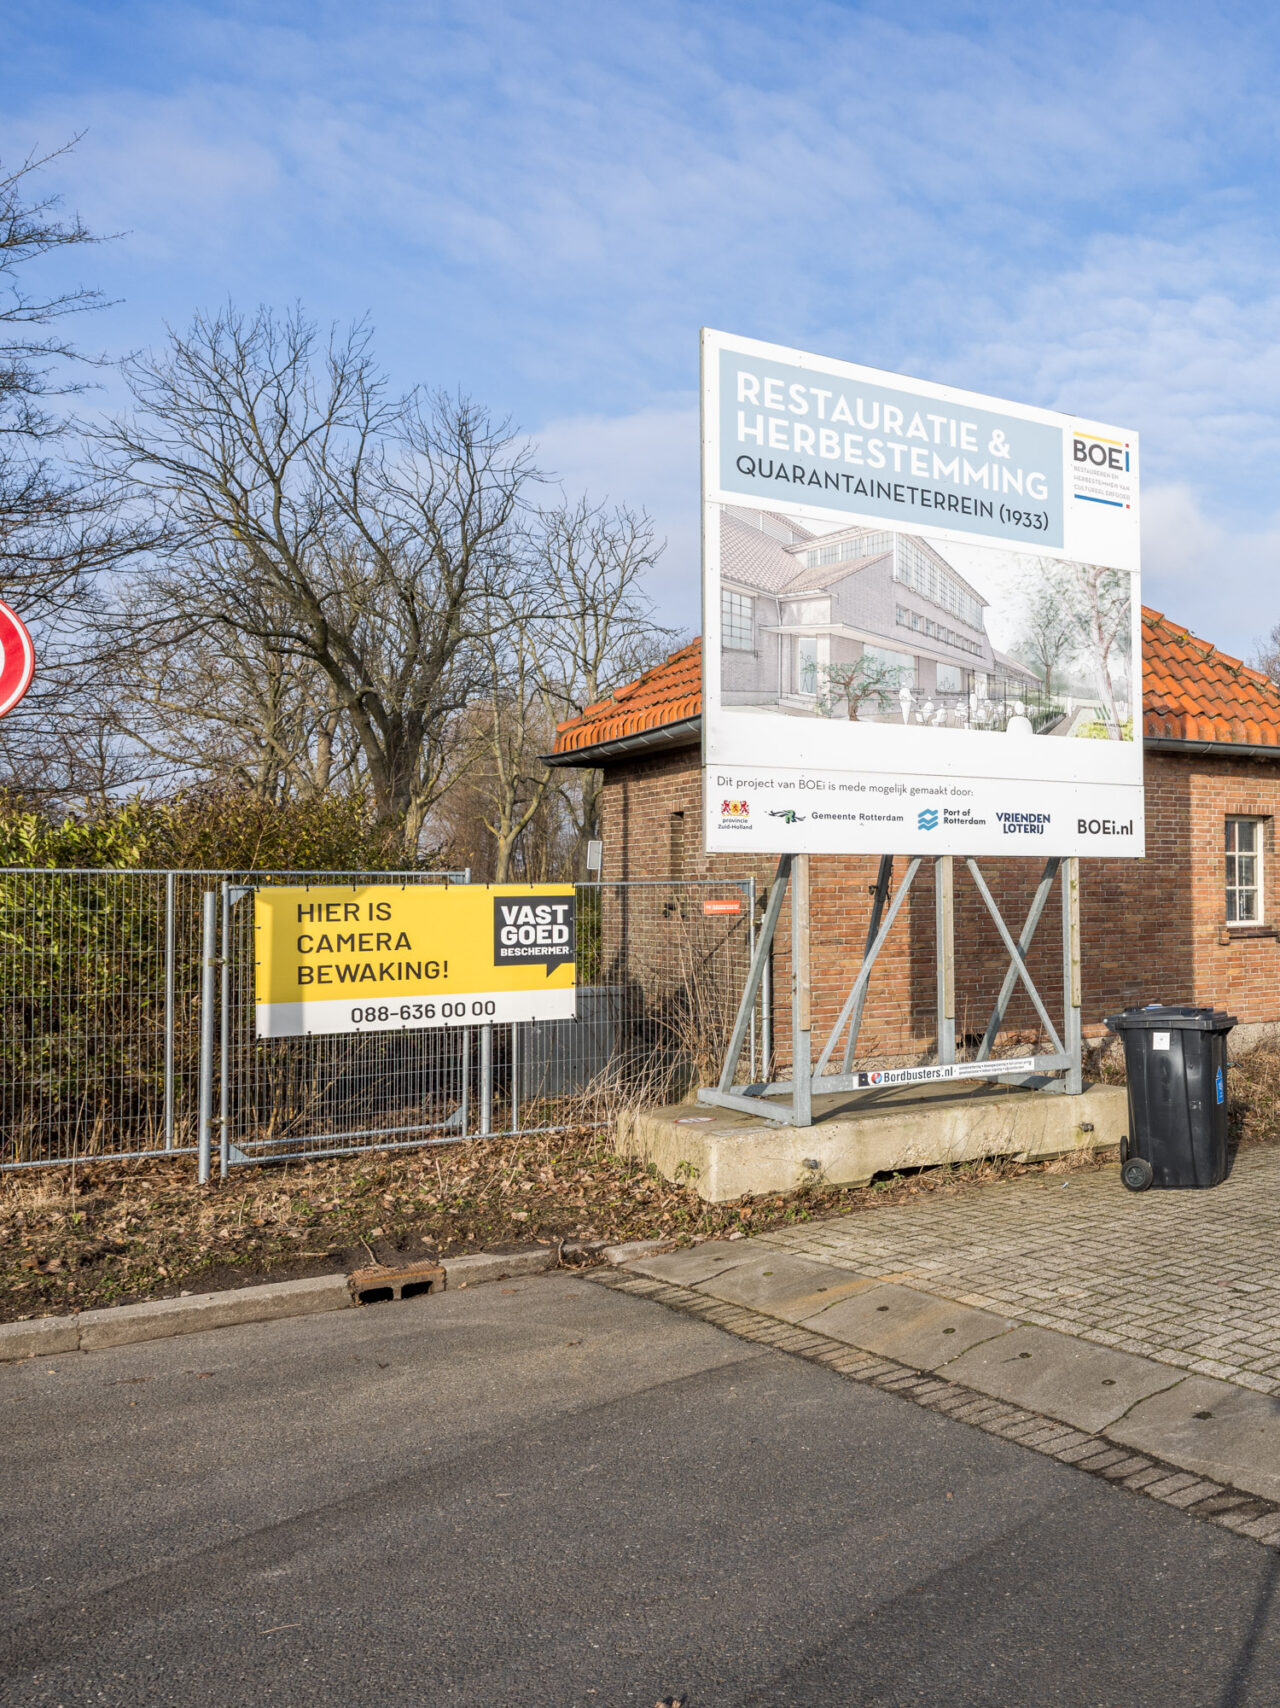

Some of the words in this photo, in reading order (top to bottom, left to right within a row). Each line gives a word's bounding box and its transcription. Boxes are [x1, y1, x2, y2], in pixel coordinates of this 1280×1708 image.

[737, 371, 978, 452] RESTAURATIE
[988, 429, 1011, 459] &
[737, 410, 1048, 500] HERBESTEMMING
[736, 455, 993, 518] QUARANTAINETERREIN
[1000, 503, 1049, 531] (1933)
[717, 776, 733, 787] Dit
[736, 778, 774, 790] project
[777, 781, 796, 789] van
[799, 779, 826, 790] BOEi
[828, 781, 836, 791] is
[839, 782, 866, 792] mede
[869, 784, 907, 796] mogelijk
[910, 786, 947, 796] gemaakt
[950, 786, 974, 797] door:
[811, 812, 856, 820] Gemeente
[859, 813, 904, 822] Rotterdam
[943, 817, 986, 825] Rotterdam
[962, 808, 971, 816] of
[996, 812, 1051, 823] VRIENDEN
[1003, 823, 1044, 835] LOTERIJ
[1077, 819, 1133, 835] BOEi.nl
[297, 903, 360, 923] HIER
[369, 902, 392, 921] IS
[500, 905, 569, 925] VAST
[297, 932, 412, 954] CAMERA
[500, 924, 569, 945] GOED
[500, 946, 570, 957] BESCHERMER
[297, 960, 448, 985] BEWAKING!
[351, 1003, 435, 1023] 088-636
[442, 1002, 466, 1018] 00
[472, 1000, 495, 1016] 00
[884, 1066, 953, 1083] Bordbusters.nl
